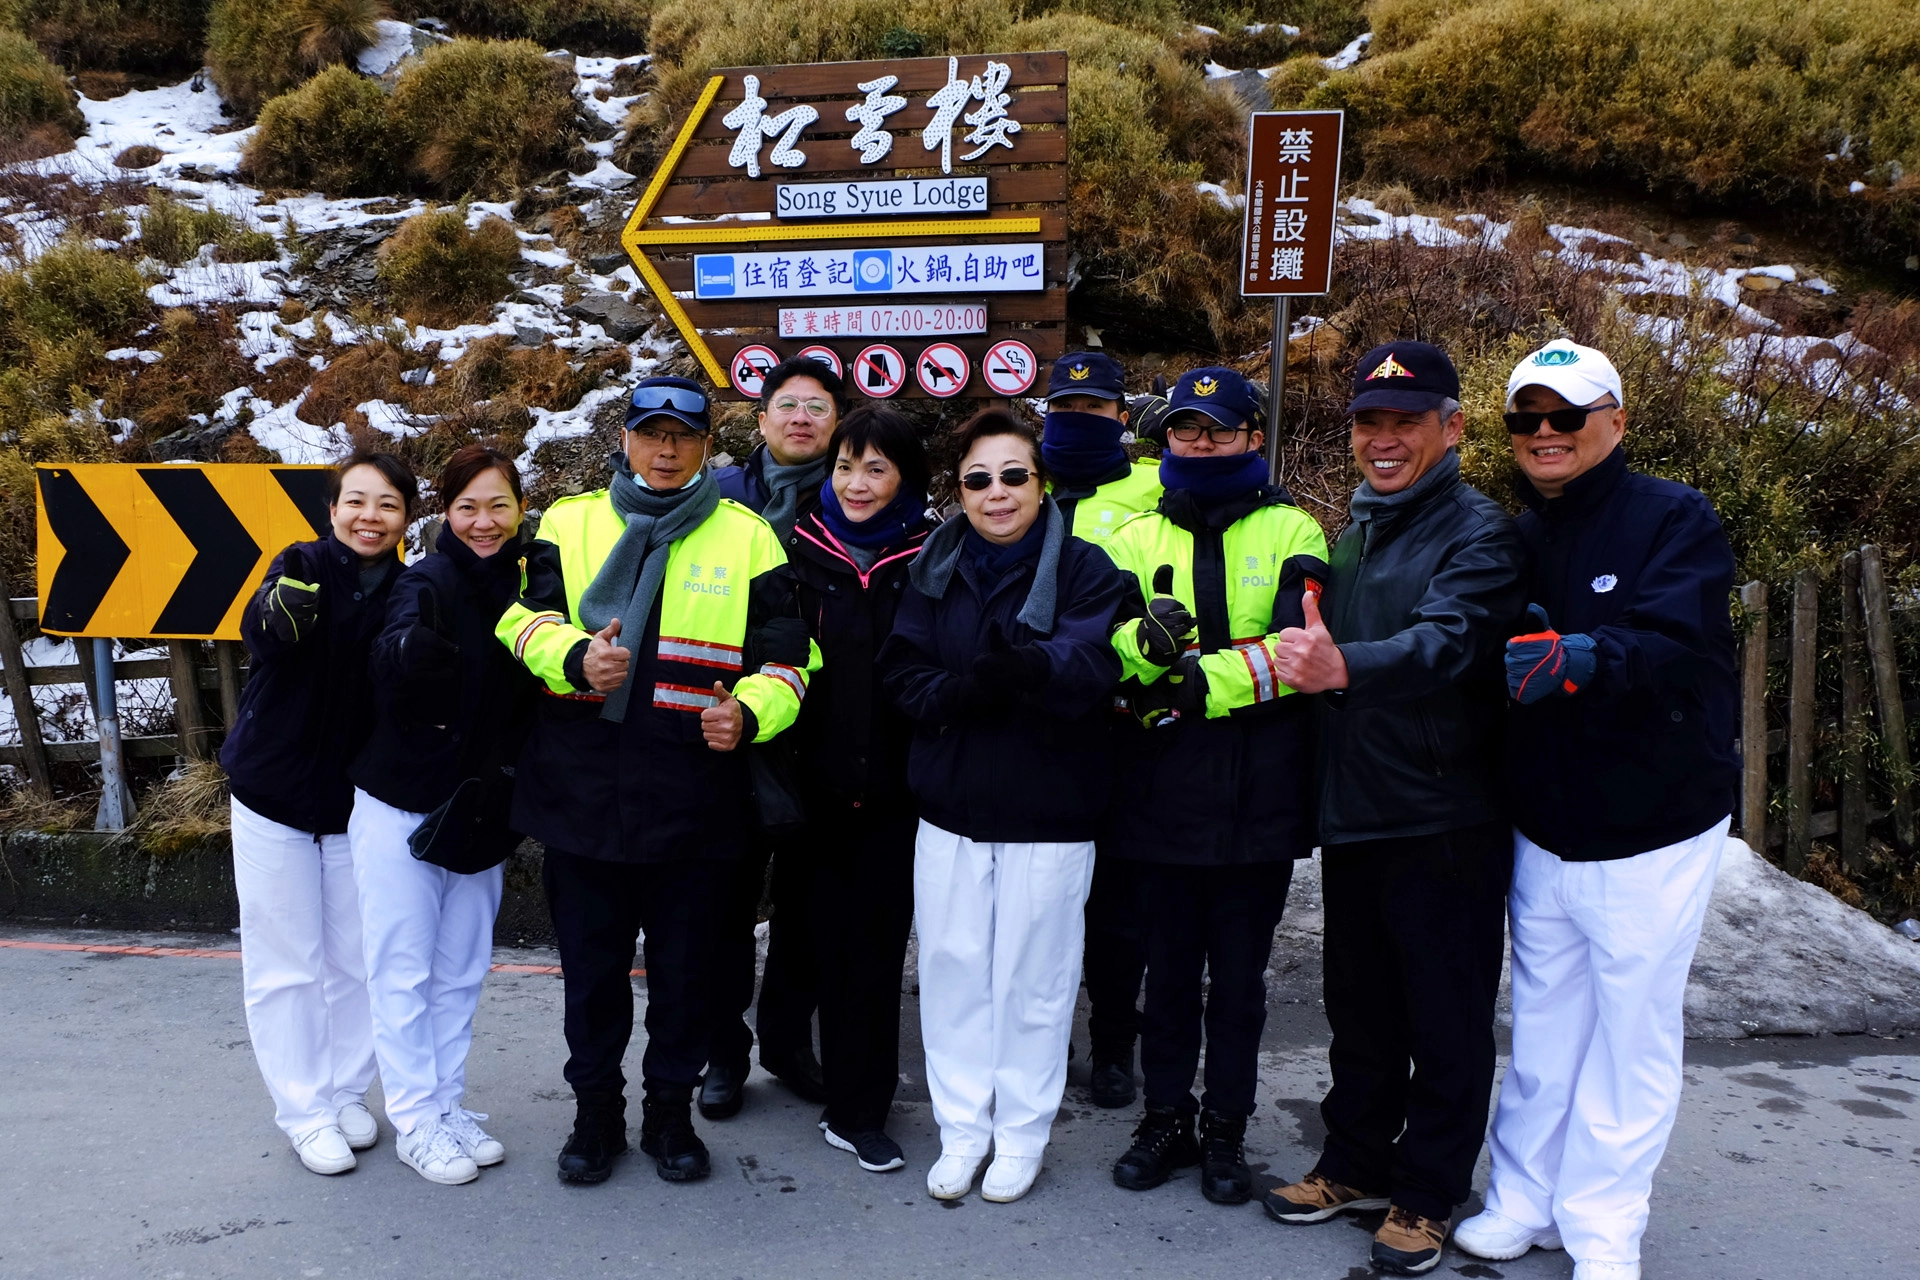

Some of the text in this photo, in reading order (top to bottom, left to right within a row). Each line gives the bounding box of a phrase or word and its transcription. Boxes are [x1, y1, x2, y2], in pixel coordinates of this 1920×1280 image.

[779, 180, 985, 213] Song Syue Lodge
[1269, 127, 1313, 281] 禁止設攤
[743, 256, 853, 290] 住宿登記
[780, 308, 986, 335] 營業時間 07:00-20:00
[683, 581, 730, 596] POLICE
